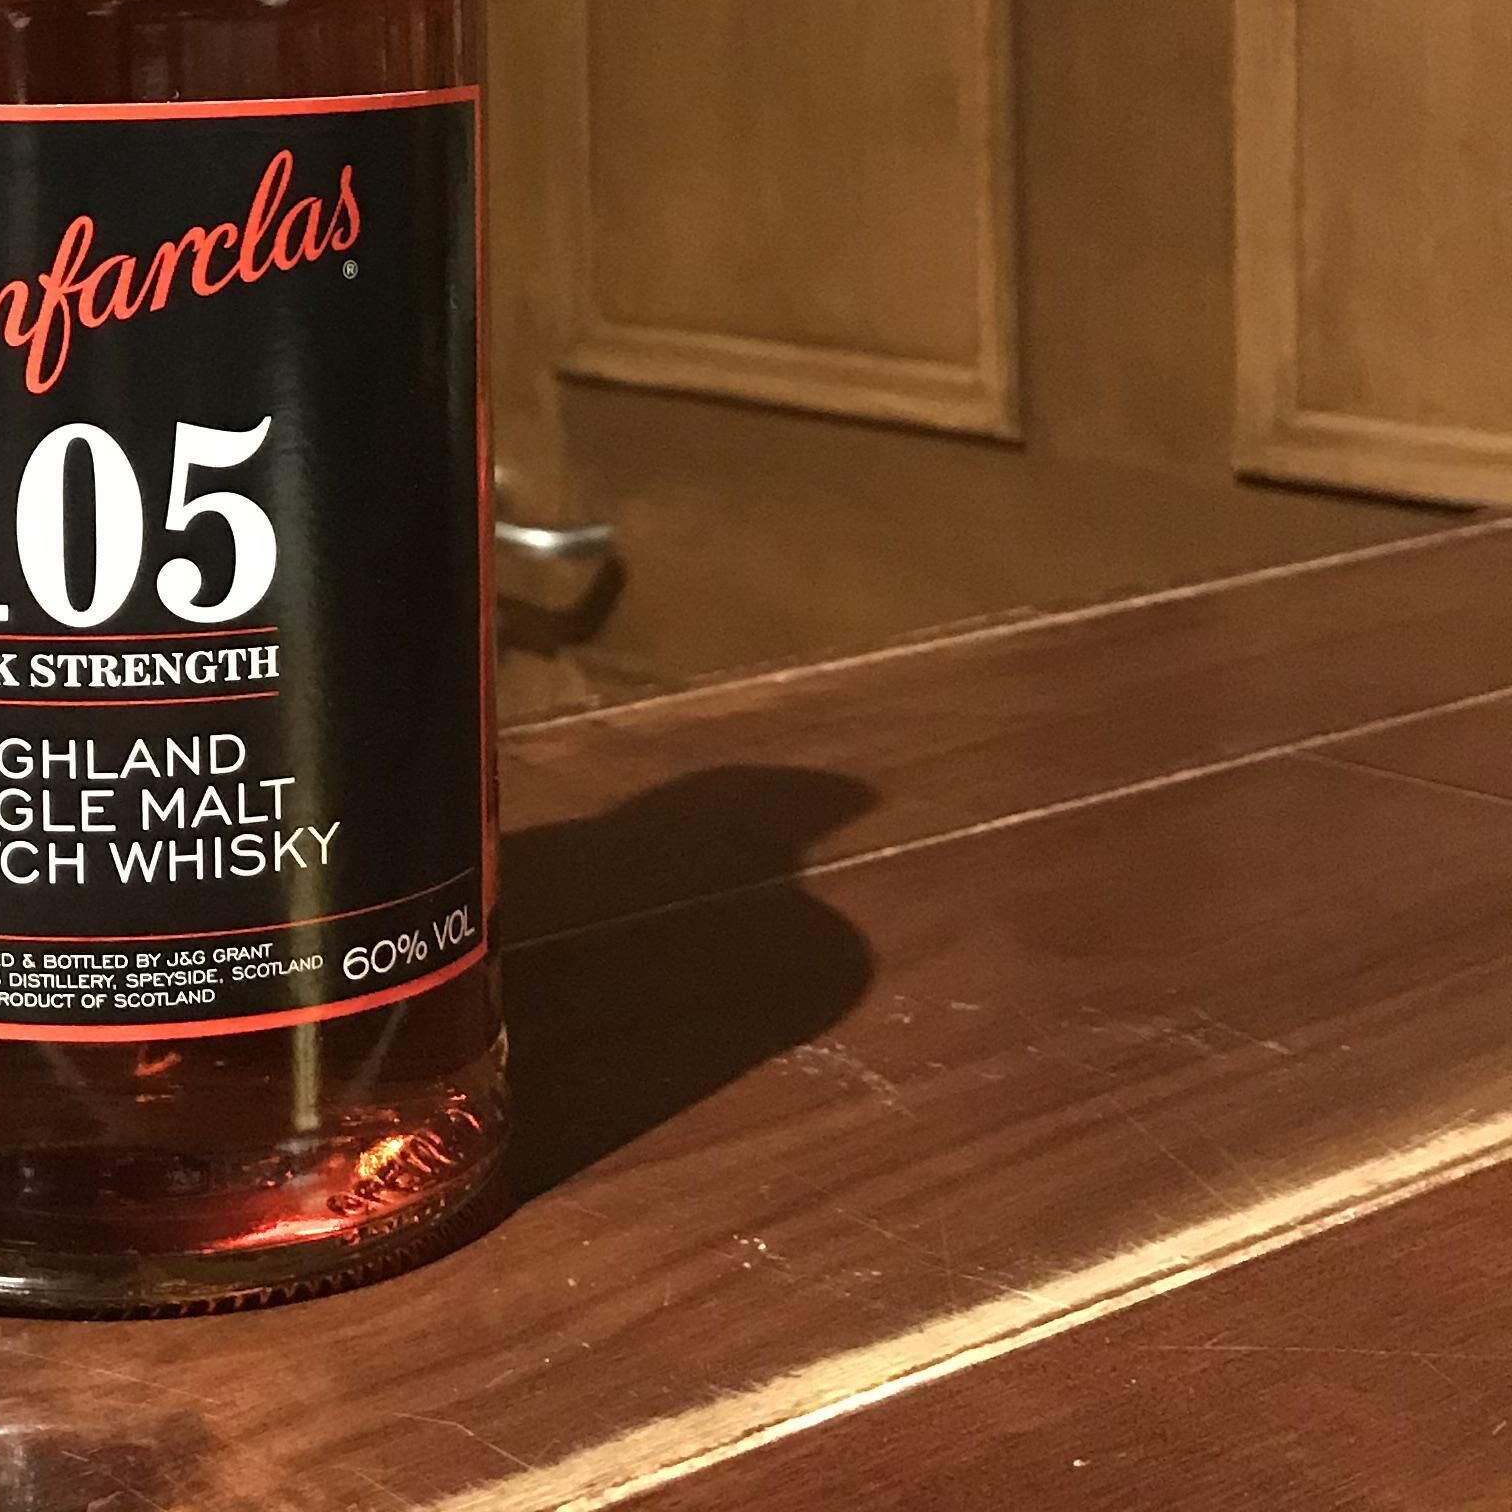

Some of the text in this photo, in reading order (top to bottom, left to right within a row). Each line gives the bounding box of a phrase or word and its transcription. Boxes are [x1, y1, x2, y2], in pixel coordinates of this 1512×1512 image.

[29, 645, 281, 688] STRENGTH
[141, 776, 296, 831] MALT
[108, 821, 341, 885] WHISKY
[22, 953, 37, 969] &
[43, 953, 129, 970] BOTTLED
[136, 952, 162, 969] BY
[166, 949, 206, 967] J&G
[212, 942, 274, 964] GRANT
[342, 904, 475, 981] 60% VOL
[8, 972, 117, 991] DISTILLERY,
[231, 954, 324, 981] SCOTLAND
[80, 993, 108, 1009] OF
[113, 988, 216, 1009] SCOTLAND
